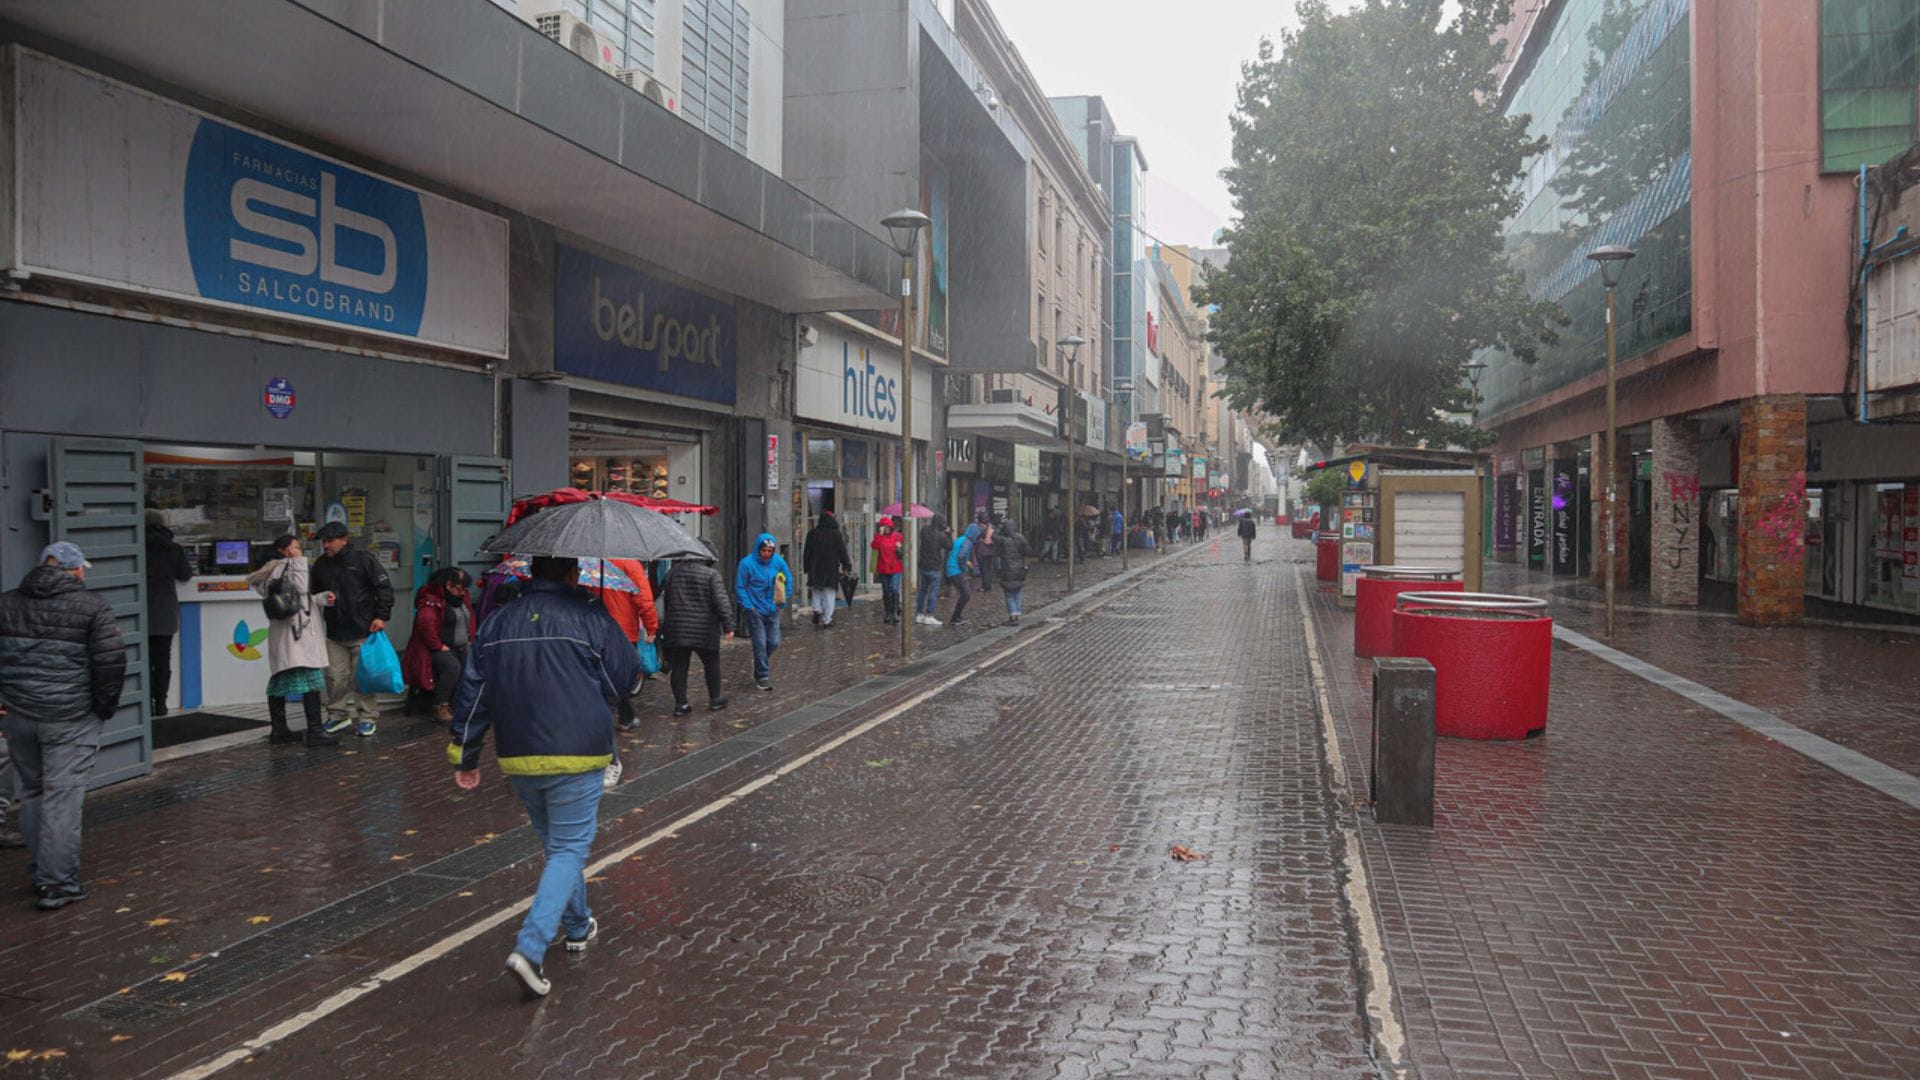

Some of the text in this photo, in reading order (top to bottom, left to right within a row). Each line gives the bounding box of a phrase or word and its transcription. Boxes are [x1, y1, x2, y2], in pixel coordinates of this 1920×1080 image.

[233, 152, 318, 190] FARMACIAS
[230, 171, 398, 294] sb
[238, 272, 395, 322] SALCOBRAND
[592, 276, 721, 372] belsport
[843, 341, 896, 422] hites
[1534, 487, 1545, 547] ENTRADA
